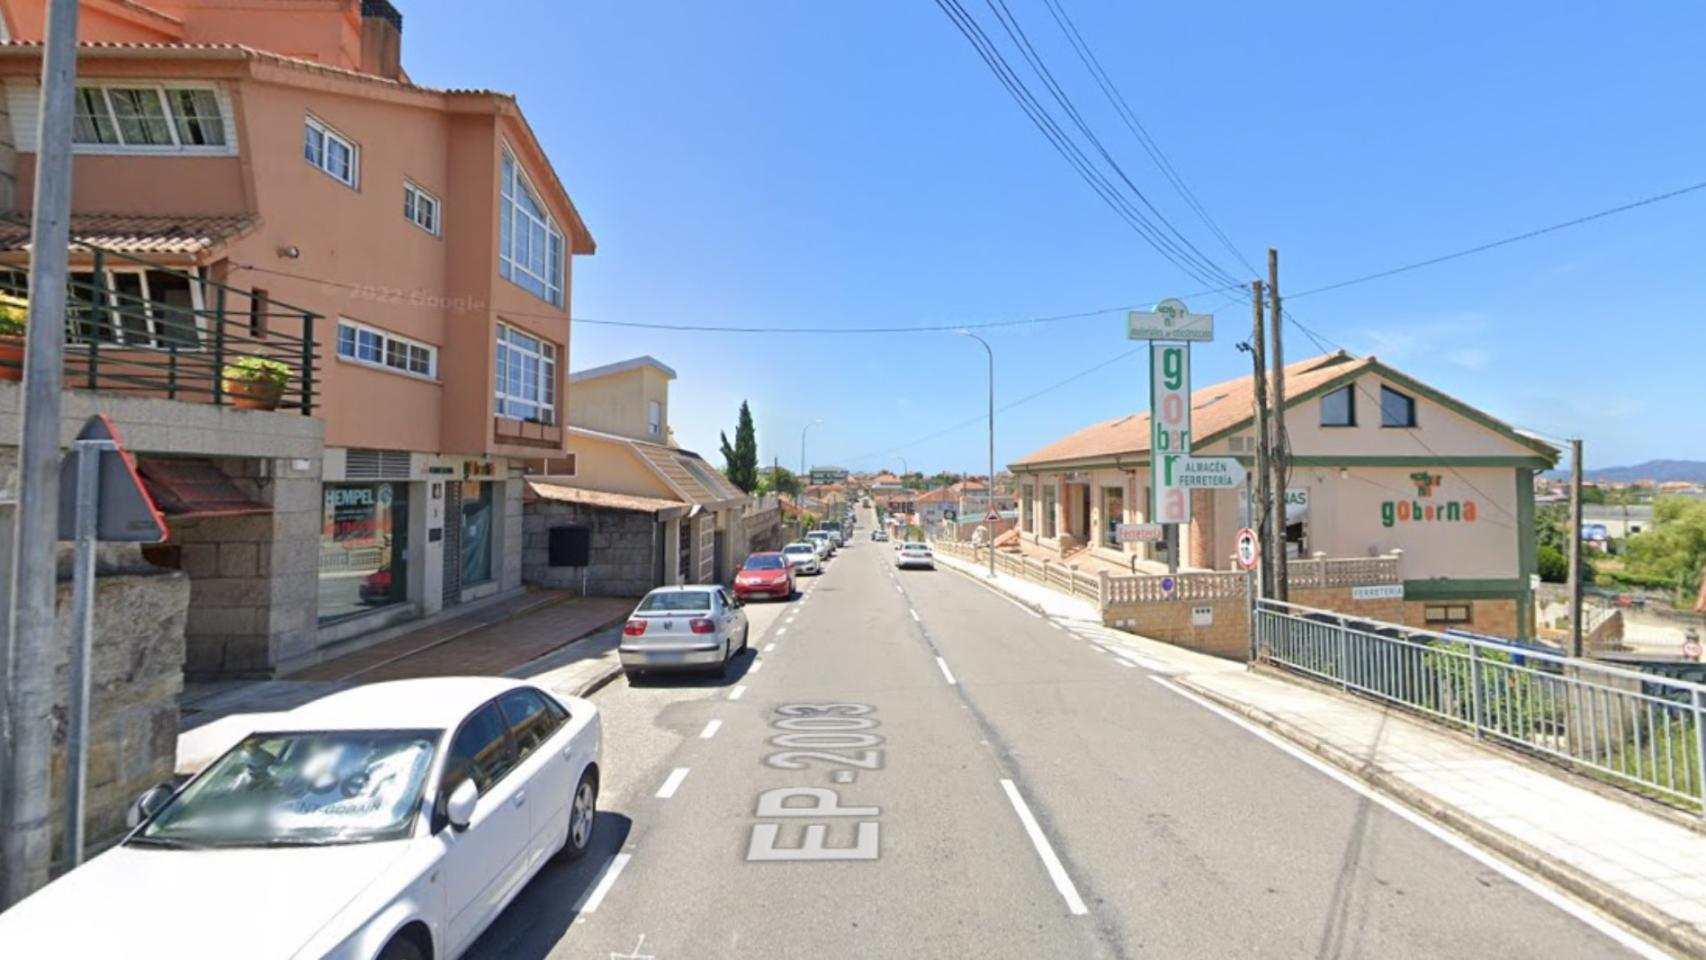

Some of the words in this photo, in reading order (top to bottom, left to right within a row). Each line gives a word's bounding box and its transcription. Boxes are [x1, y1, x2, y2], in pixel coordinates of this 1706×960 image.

[1185, 460, 1227, 472] ALMACÉN
[1179, 474, 1233, 486] FERRETERÍA
[324, 488, 376, 508] HEMPEL
[1381, 500, 1477, 528] goberna
